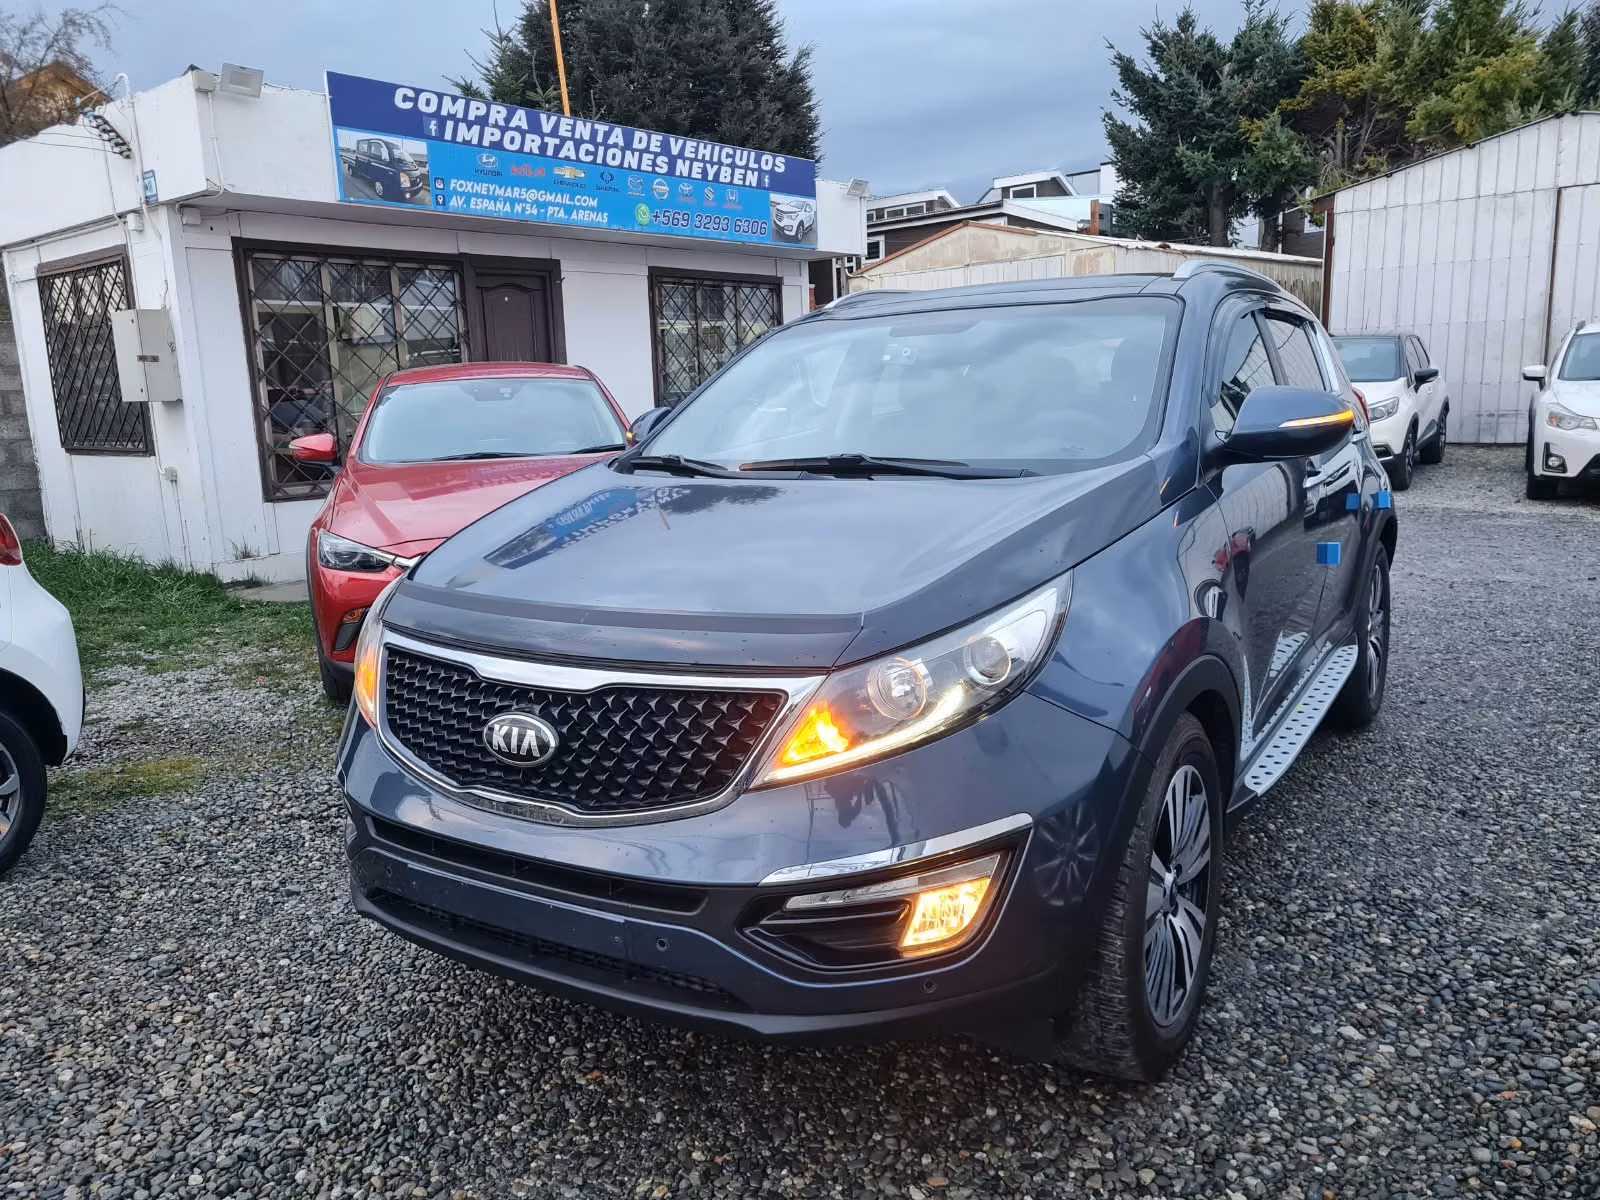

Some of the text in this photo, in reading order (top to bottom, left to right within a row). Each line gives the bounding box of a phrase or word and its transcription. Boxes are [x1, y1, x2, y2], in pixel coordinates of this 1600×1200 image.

[394, 87, 786, 173] COMPRA VENTA DE VEHICULOS
[444, 119, 669, 174] IMPORTACIONES
[675, 159, 759, 187] NEYBEN
[450, 179, 598, 207] FOXNEYMAR5@GMAIL.COM
[450, 195, 467, 208] AV.
[470, 195, 511, 213] ESPAÑA
[547, 206, 568, 219] PTA.
[571, 209, 609, 222] ARENAS
[652, 209, 768, 236] +569 3293 6306
[492, 724, 540, 756] KIA
